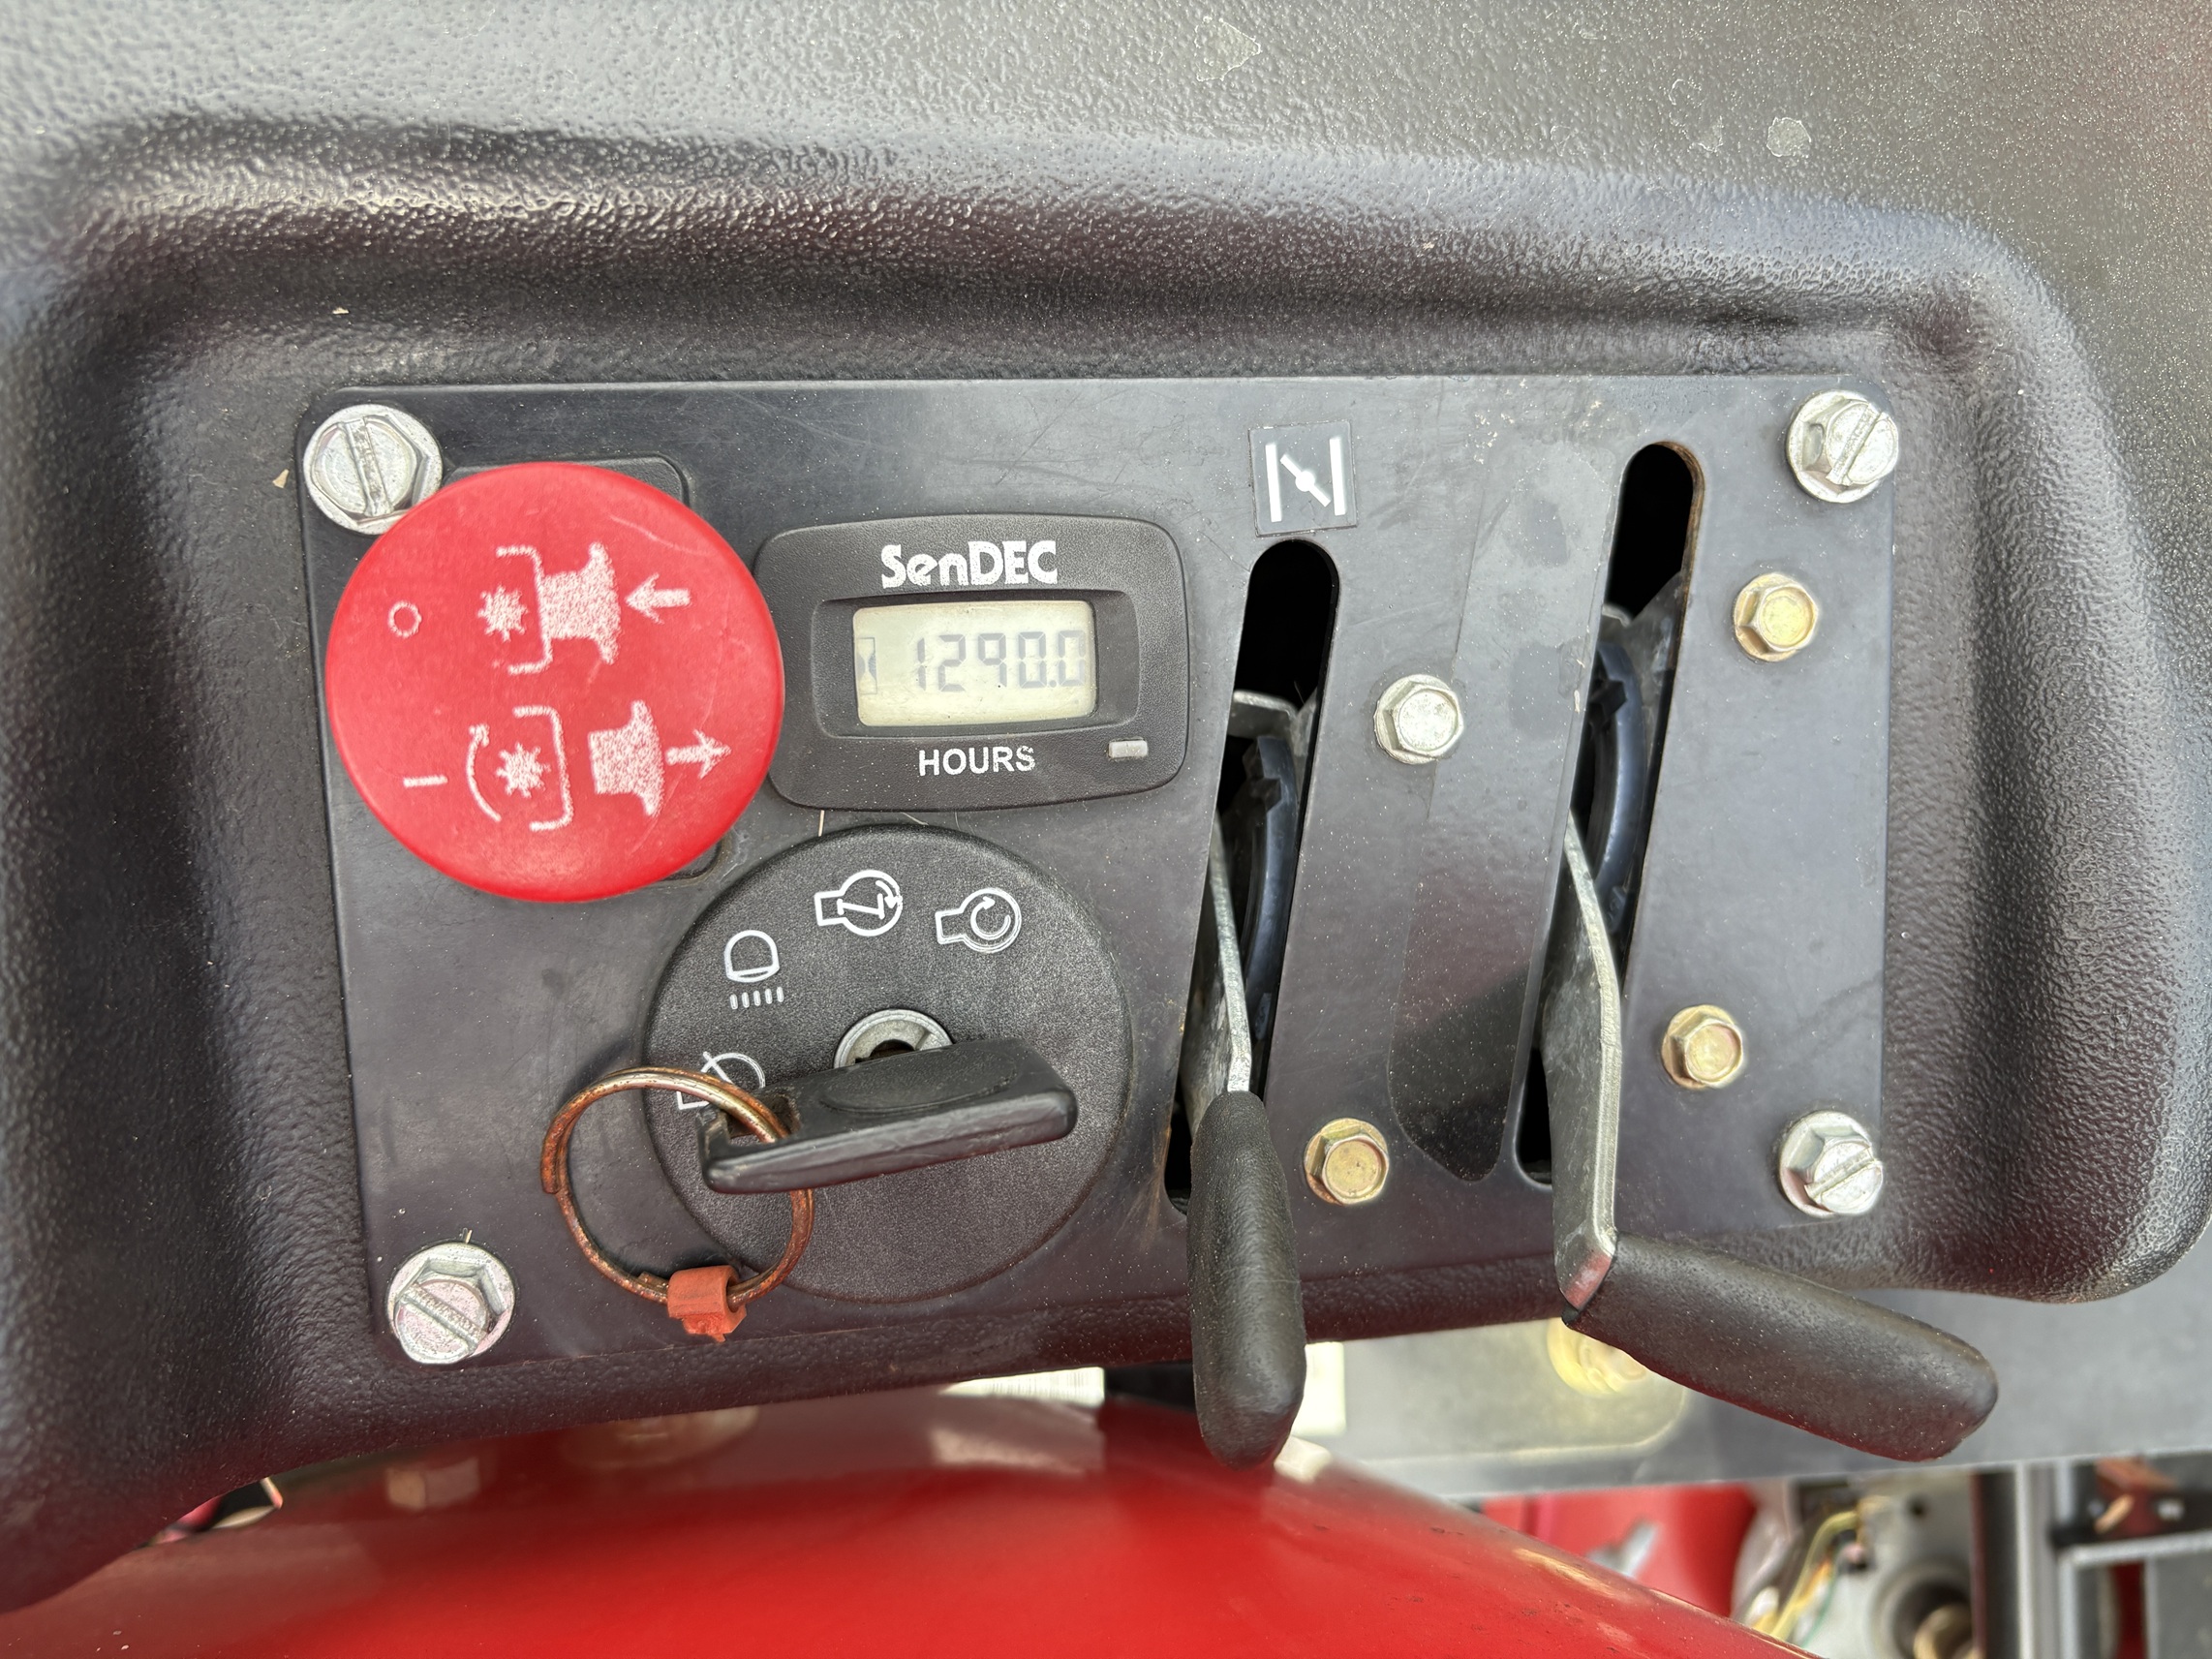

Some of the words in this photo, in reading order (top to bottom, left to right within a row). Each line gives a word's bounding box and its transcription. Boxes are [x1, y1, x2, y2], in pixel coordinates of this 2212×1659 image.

[880, 540, 1059, 589] SenDEC
[916, 631, 1085, 692] 1290.0
[918, 746, 1036, 777] HOURS
